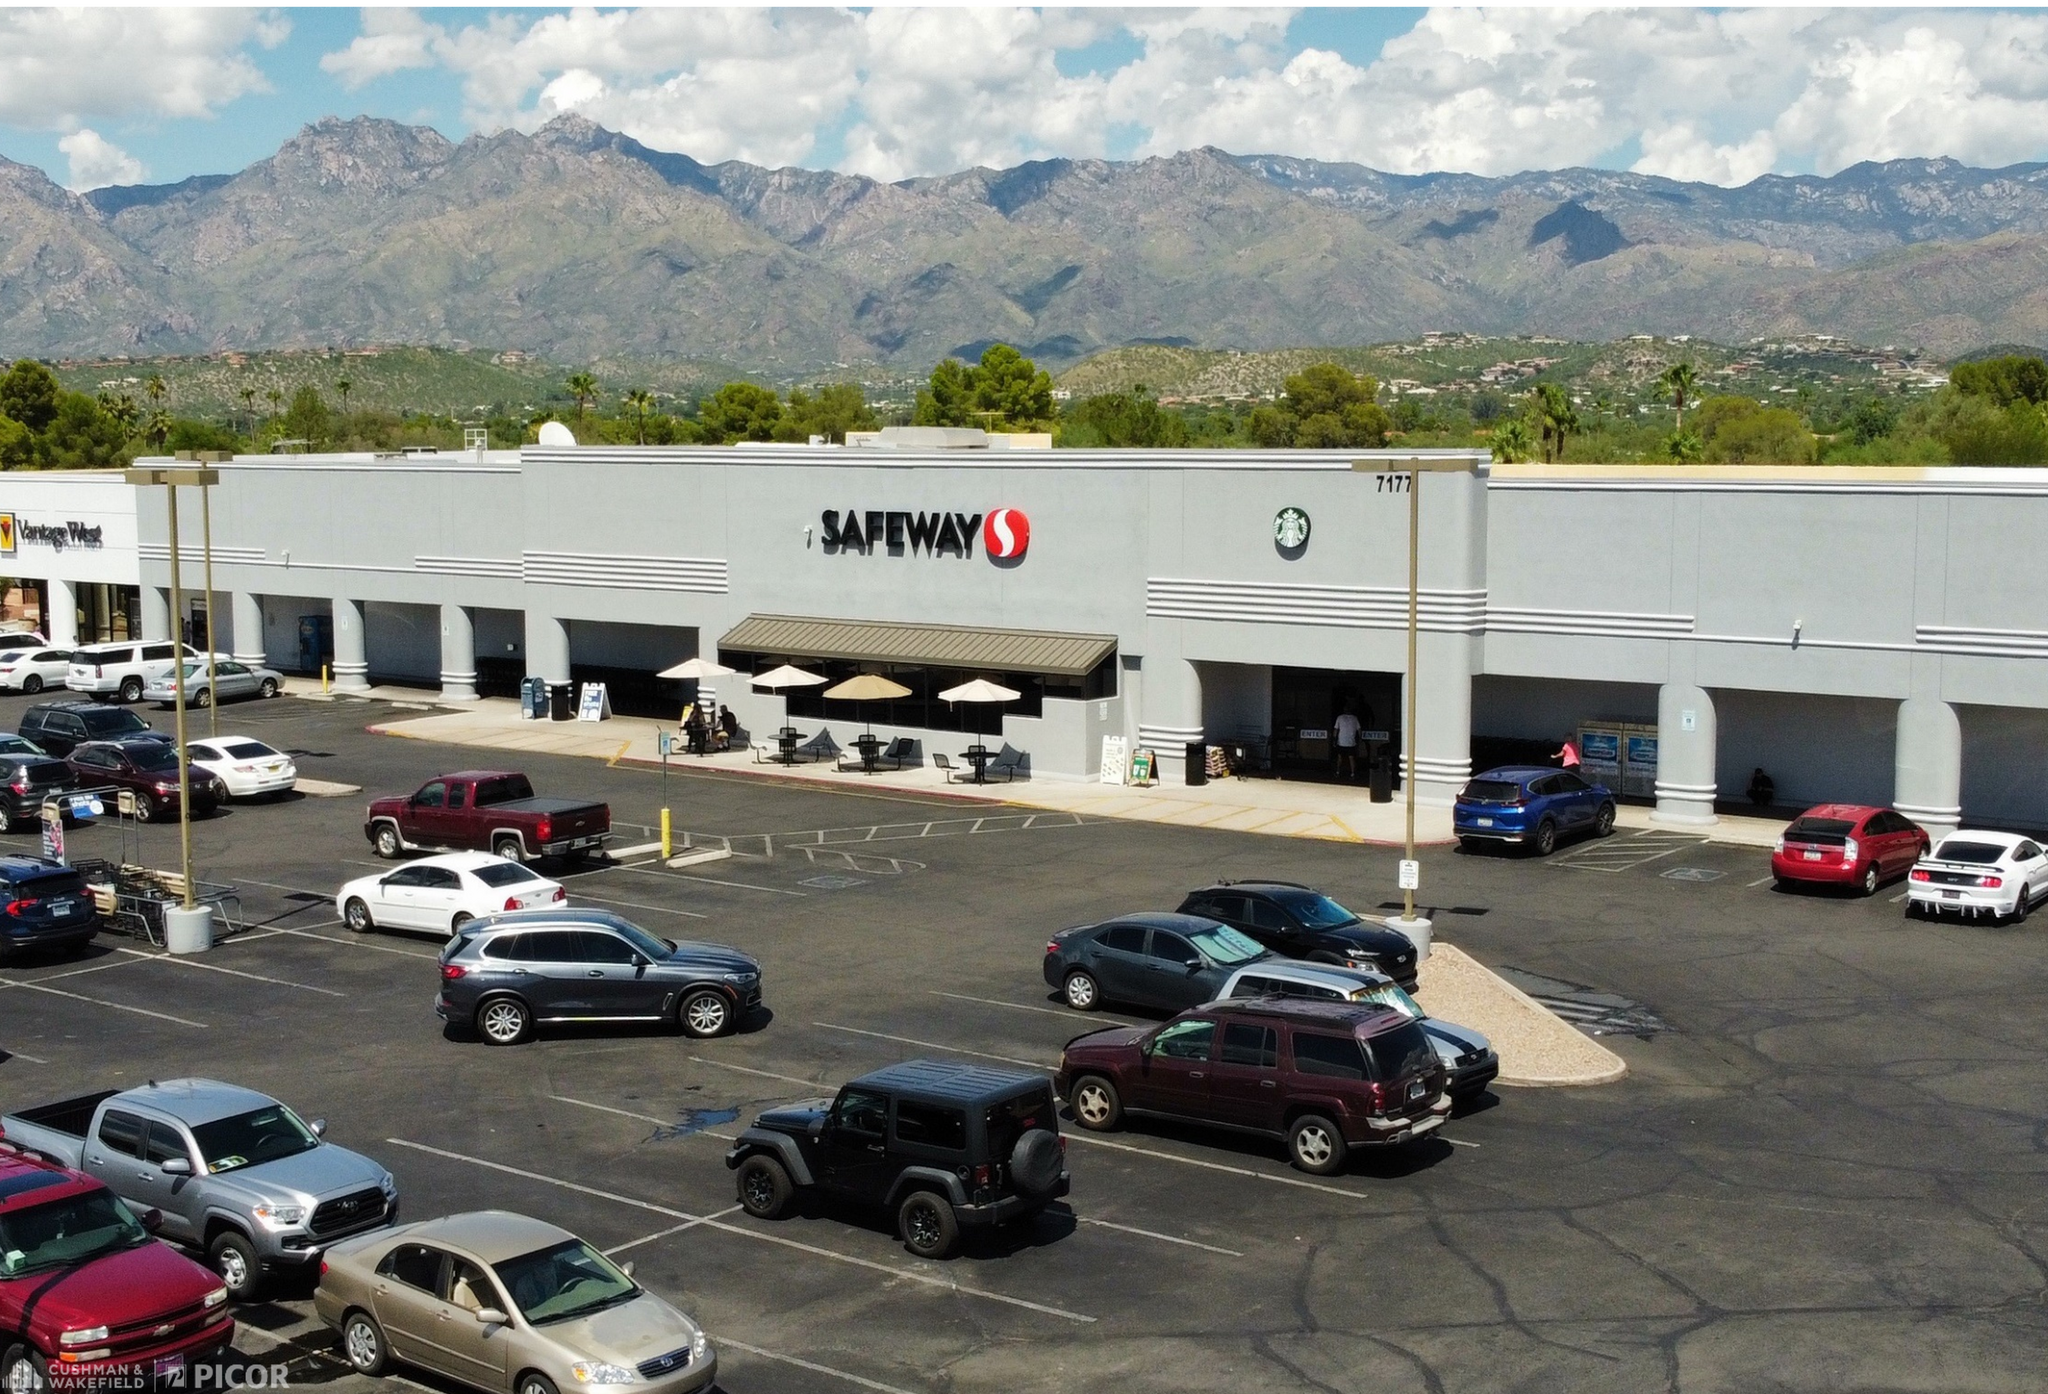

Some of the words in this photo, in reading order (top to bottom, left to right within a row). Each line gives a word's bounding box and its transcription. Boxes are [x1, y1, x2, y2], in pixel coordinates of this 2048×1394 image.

[1376, 475, 1411, 493] 7177
[17, 519, 68, 549] Vantage
[66, 521, 102, 543] West
[821, 509, 983, 556] SAFEWAY
[1302, 730, 1326, 738] ENTER
